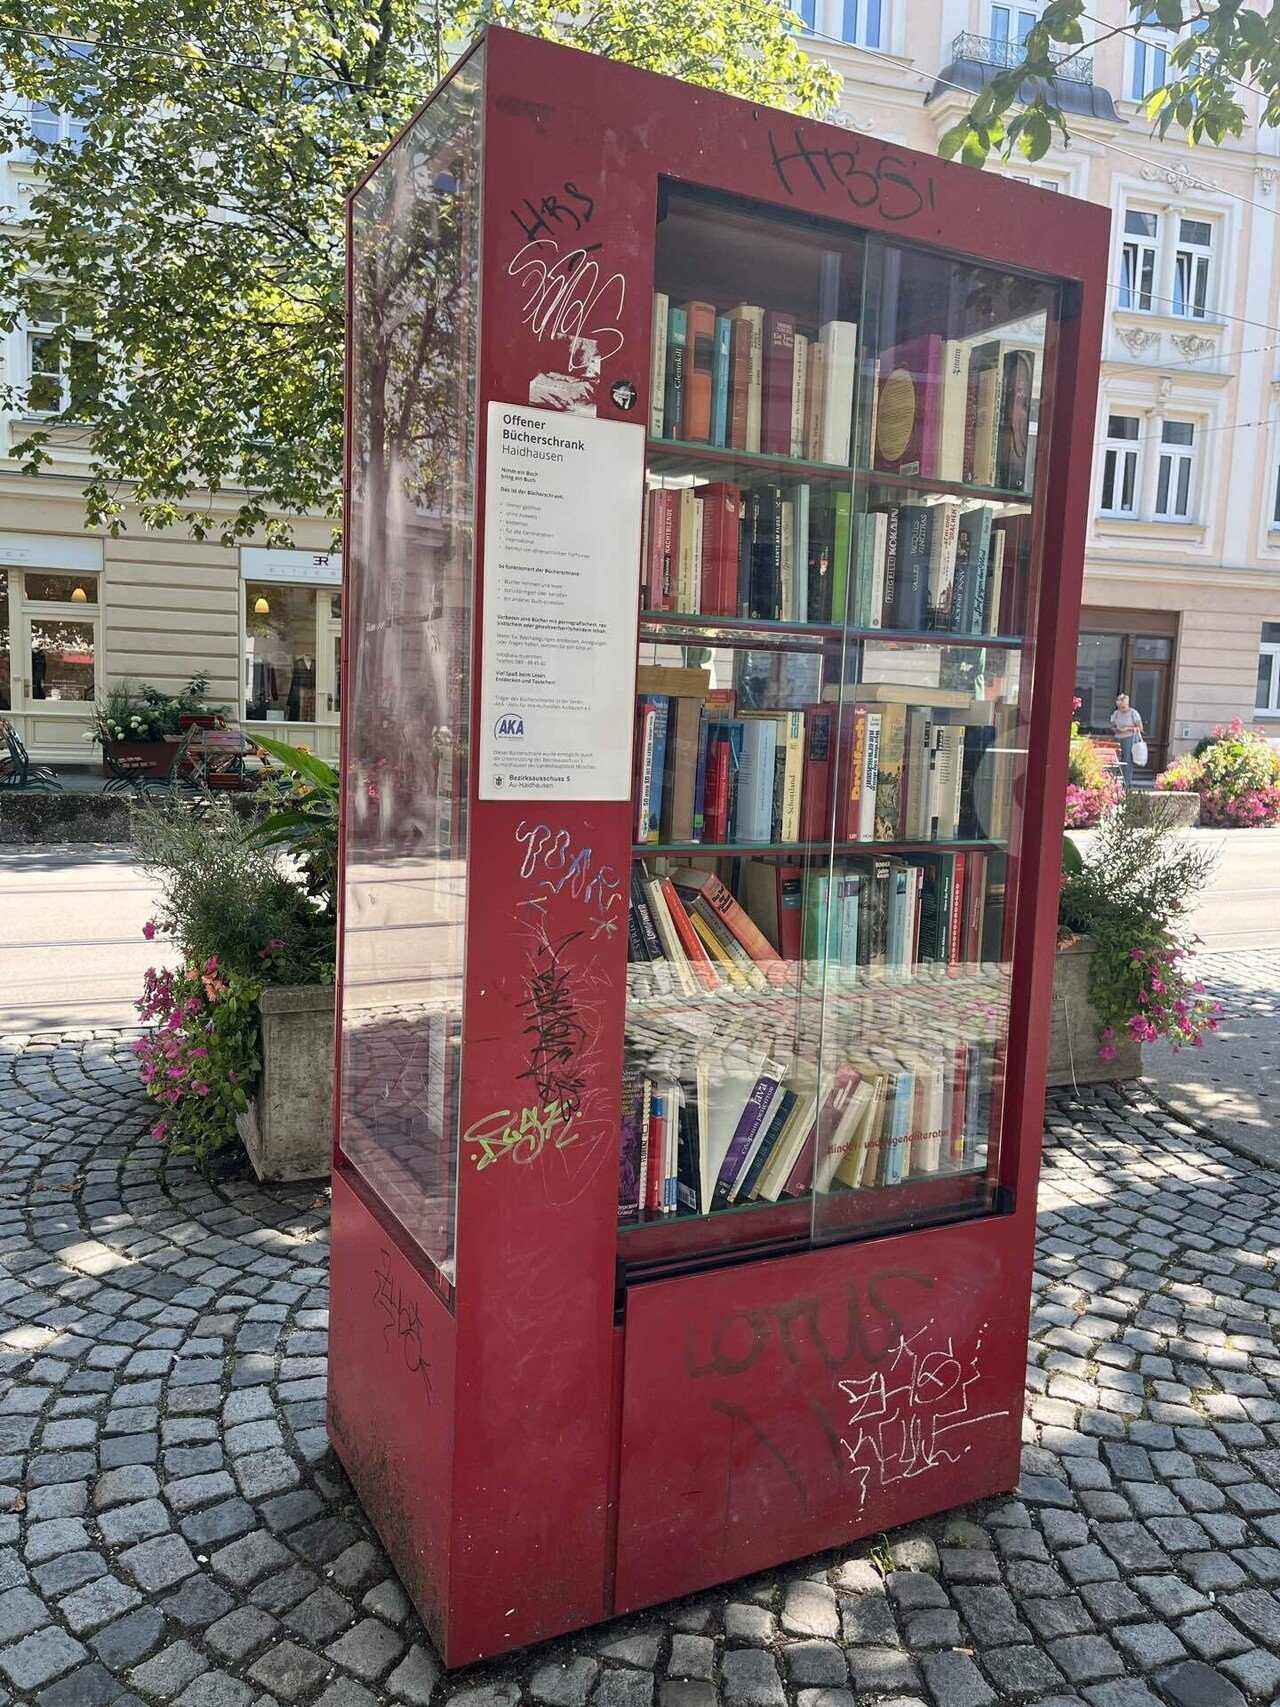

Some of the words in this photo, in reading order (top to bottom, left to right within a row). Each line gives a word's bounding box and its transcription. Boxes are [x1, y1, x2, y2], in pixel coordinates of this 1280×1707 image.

[672, 347, 683, 388] Glennkill
[503, 414, 545, 430] Offener
[502, 444, 564, 462] Haidhausen
[503, 429, 585, 450] Bücherschrank
[776, 535, 780, 543] AM
[889, 508, 899, 555] KOKAIN
[918, 513, 927, 555] VINGTRAS
[498, 719, 524, 734] AKA
[850, 718, 865, 800] Dreifach
[787, 775, 796, 815] Schottland
[638, 903, 656, 940] LONGFINGER
[750, 1083, 767, 1109] Java
[865, 1138, 880, 1149] und
[685, 1268, 933, 1379] LOTUS
